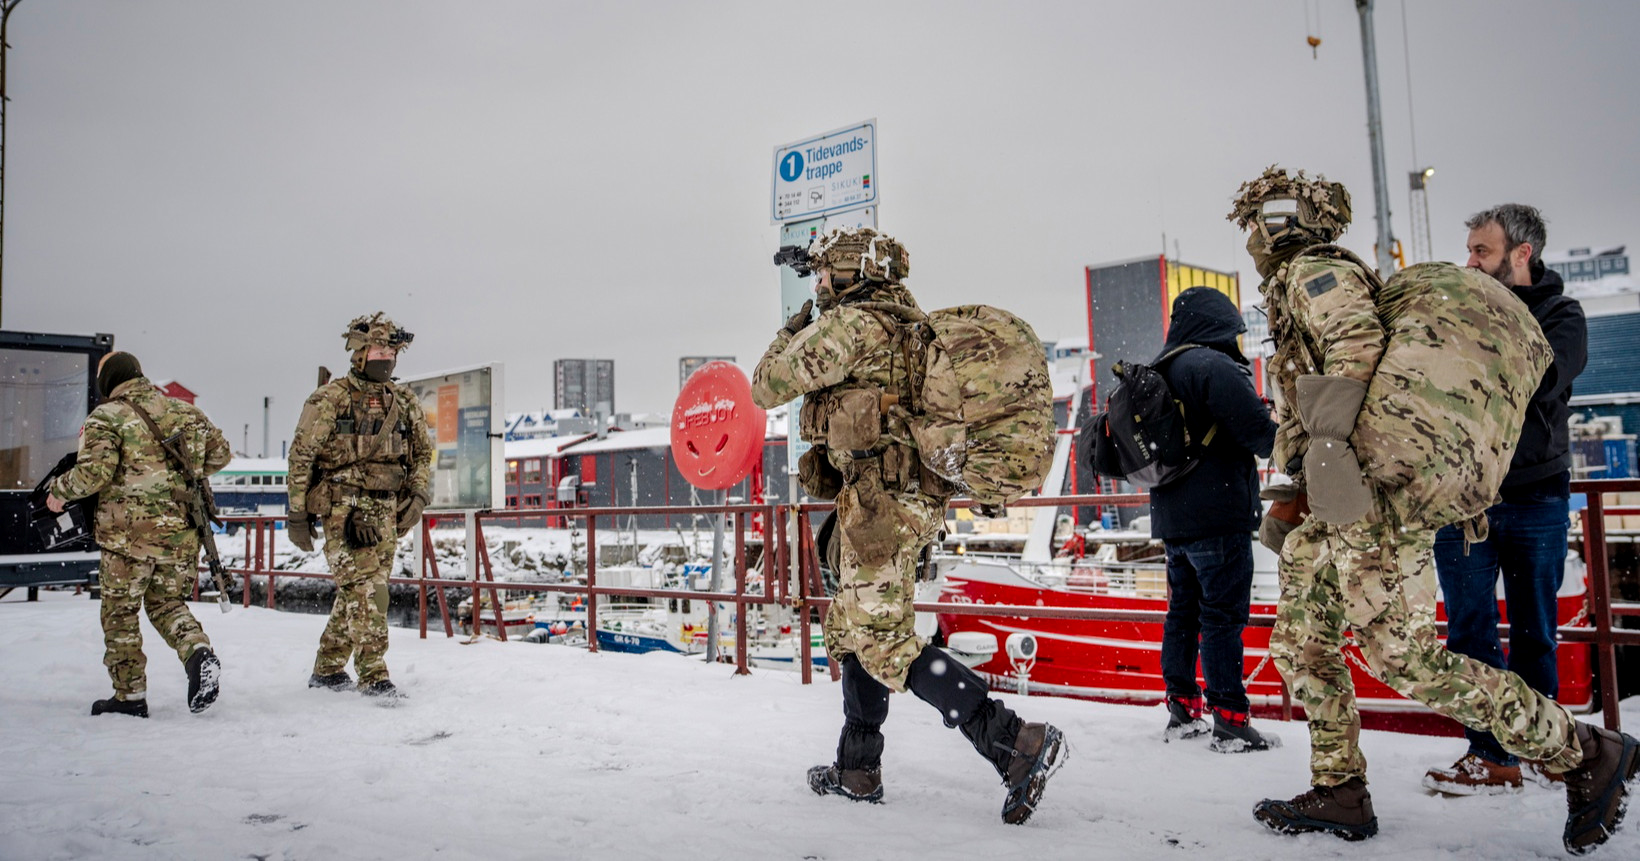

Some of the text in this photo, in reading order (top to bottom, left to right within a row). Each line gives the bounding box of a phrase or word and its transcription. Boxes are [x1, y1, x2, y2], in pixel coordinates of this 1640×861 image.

[806, 136, 868, 164] Tidevands-
[787, 154, 795, 177] 1
[806, 160, 843, 180] trappe
[831, 177, 861, 191] SIKUKI
[783, 228, 809, 240] SIKUKI
